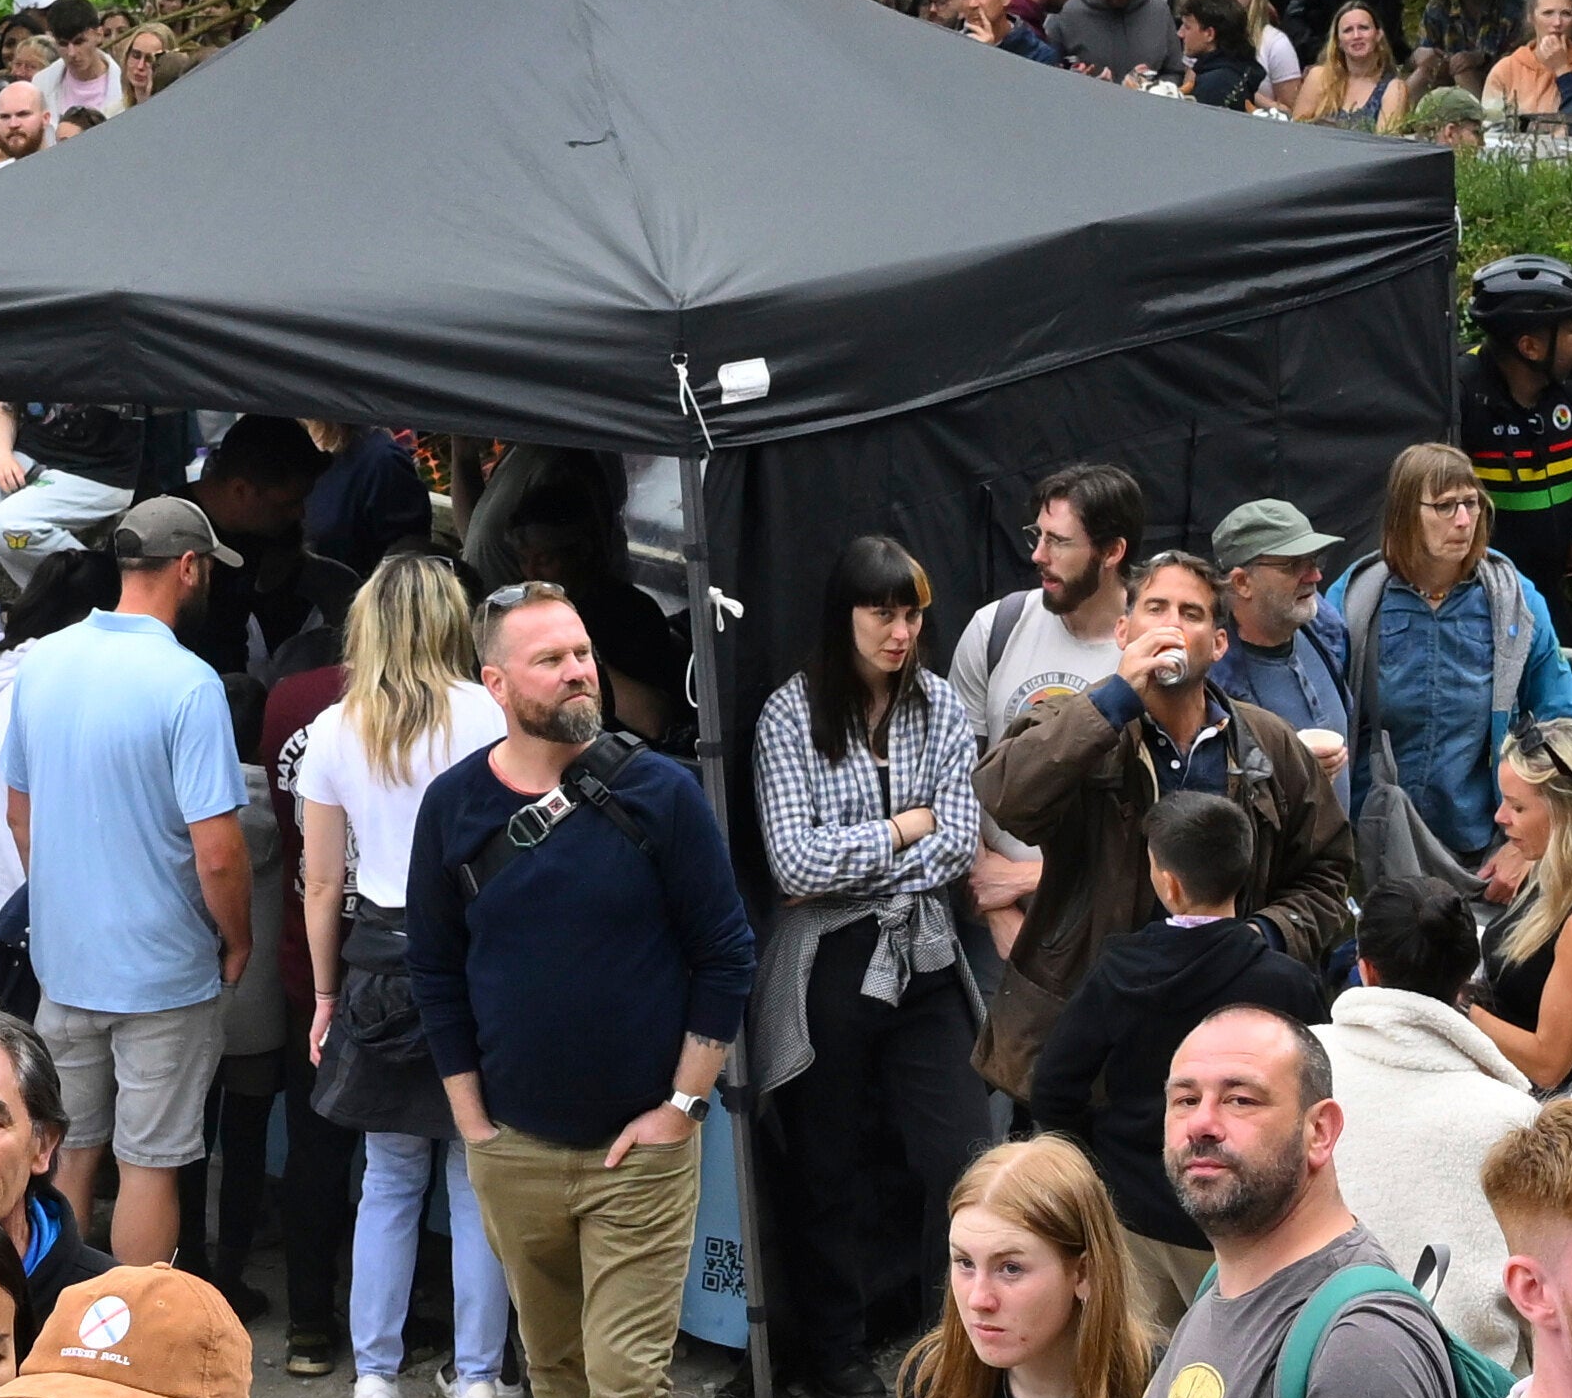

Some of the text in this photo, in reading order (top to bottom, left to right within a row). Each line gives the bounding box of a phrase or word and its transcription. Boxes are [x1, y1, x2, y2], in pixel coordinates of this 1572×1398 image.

[1021, 672, 1061, 694] KICKING
[60, 1347, 131, 1366] CHEESE ROLL
